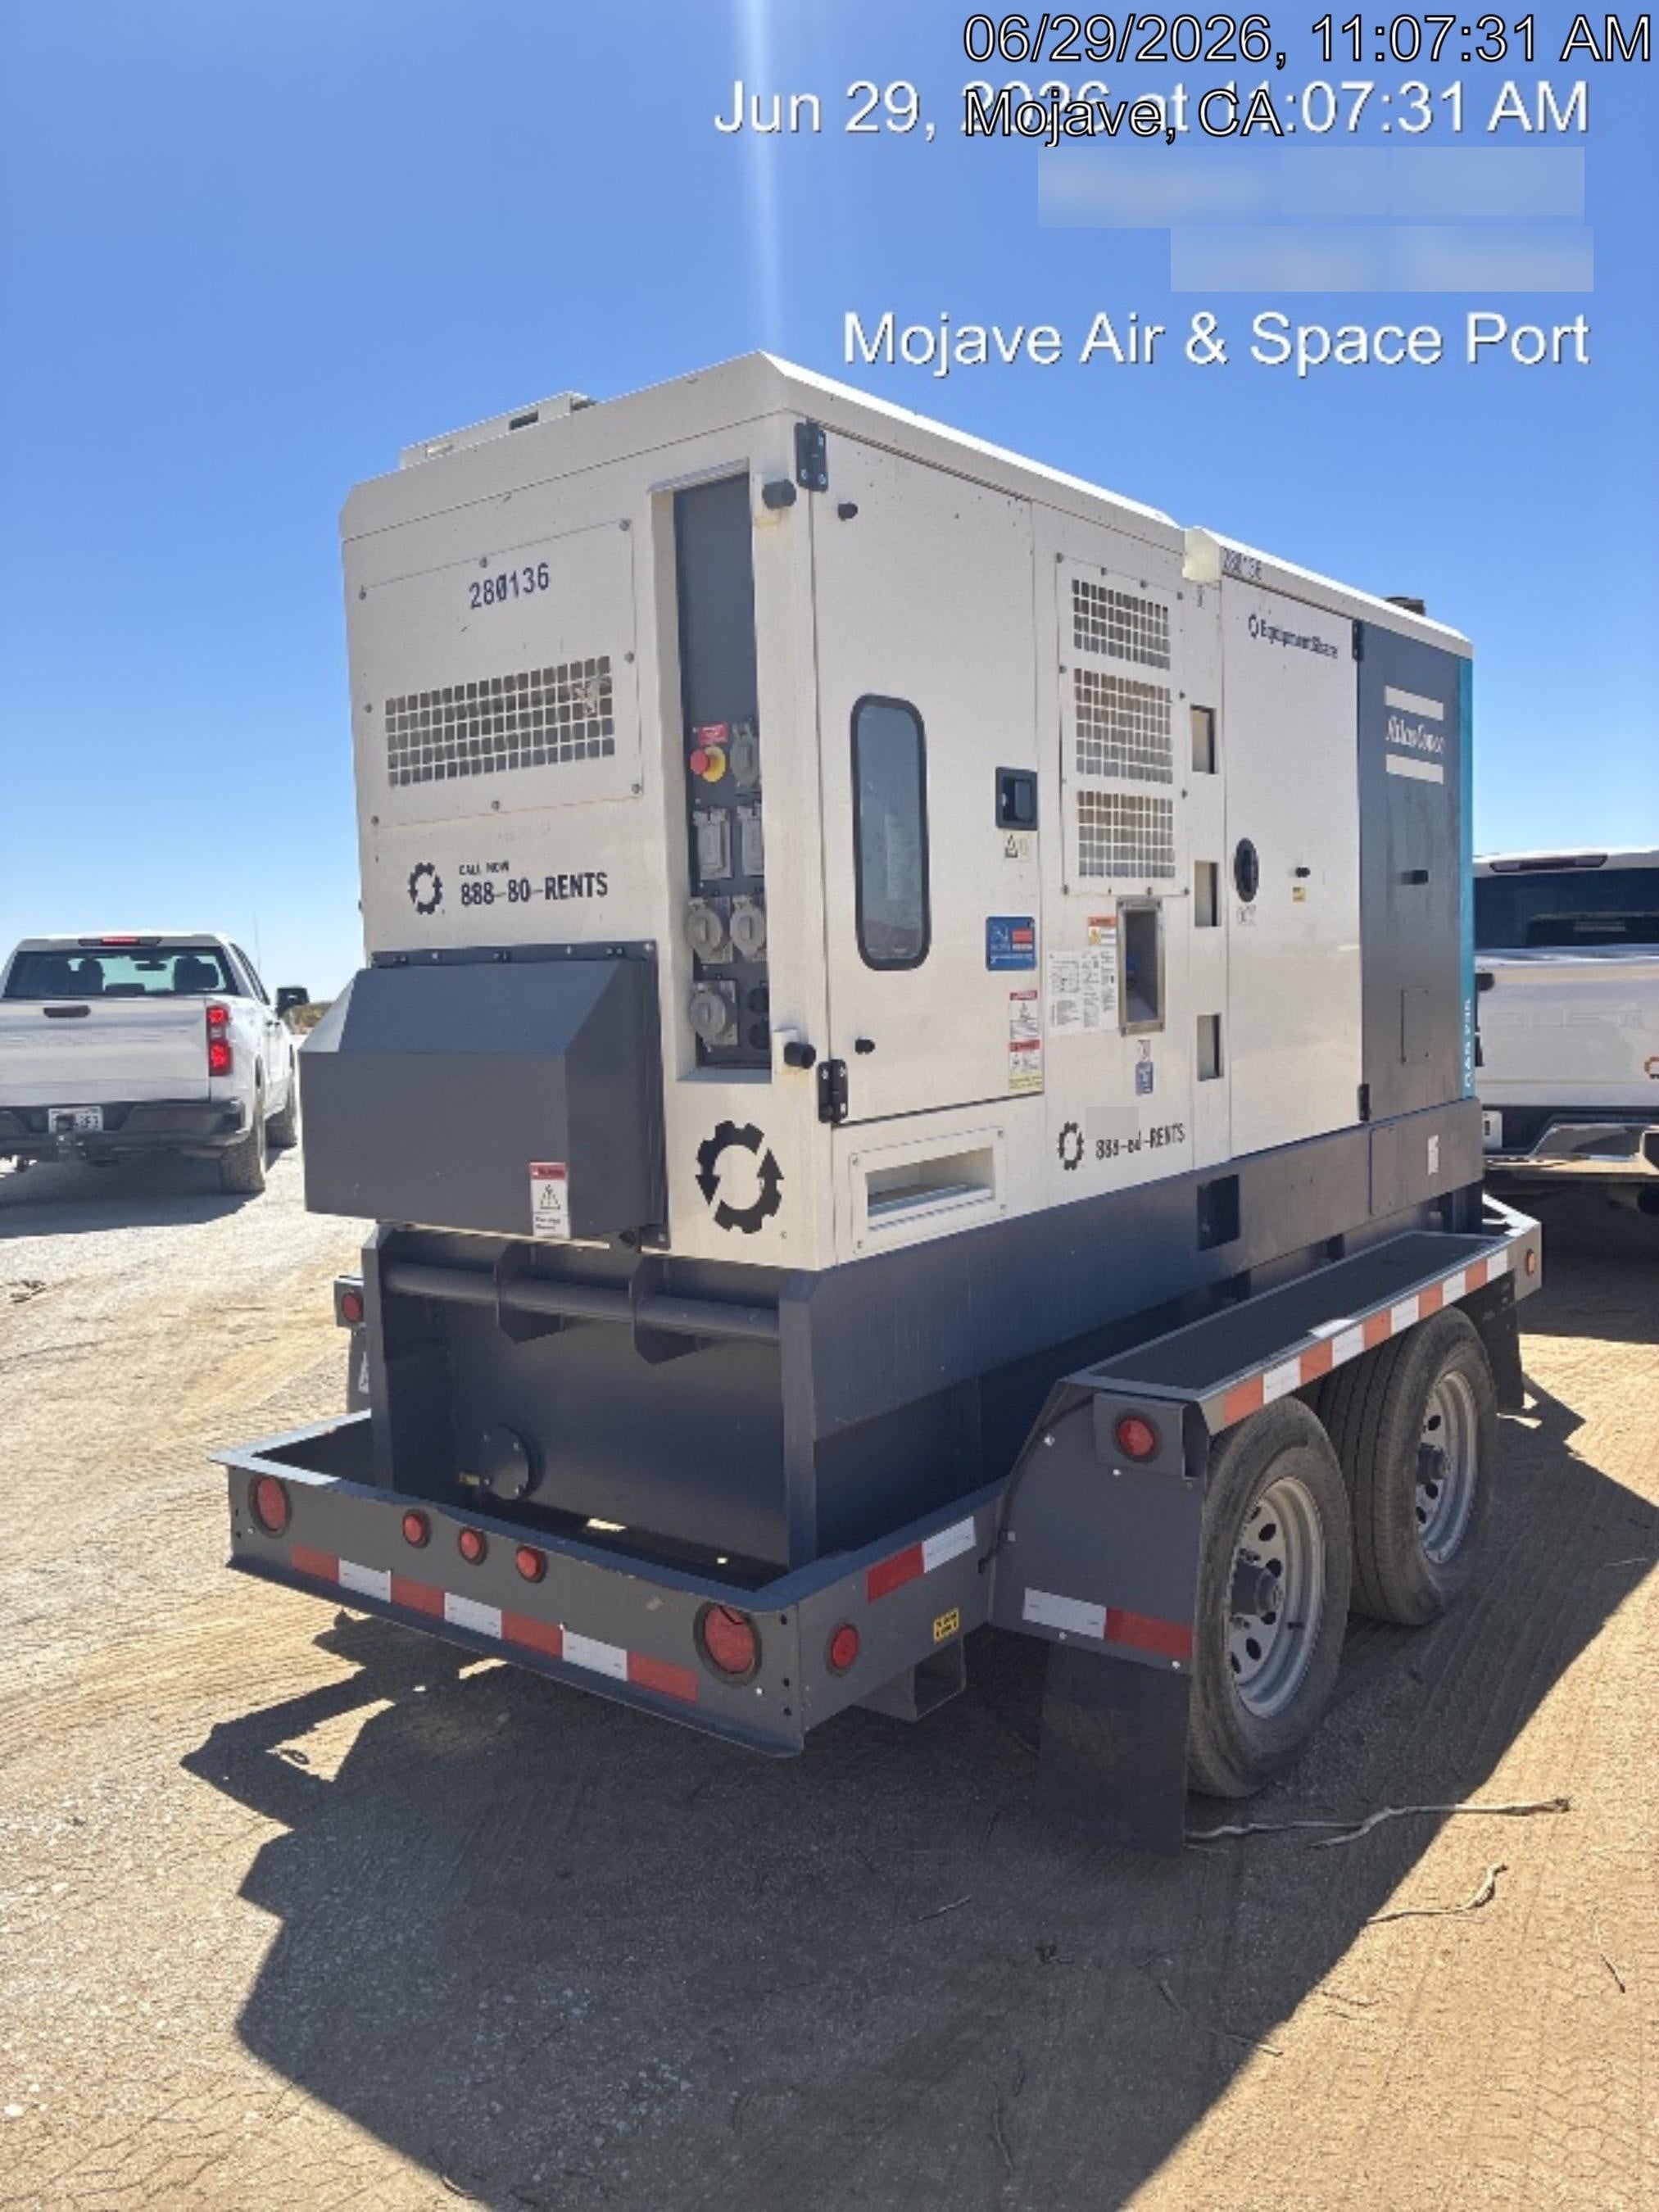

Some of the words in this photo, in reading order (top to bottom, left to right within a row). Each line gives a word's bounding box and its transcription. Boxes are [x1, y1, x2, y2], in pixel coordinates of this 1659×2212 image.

[469, 562, 550, 610] 280136
[459, 864, 481, 876] CALL
[486, 860, 510, 873] NOW
[460, 872, 608, 907] 888-80-RENTS
